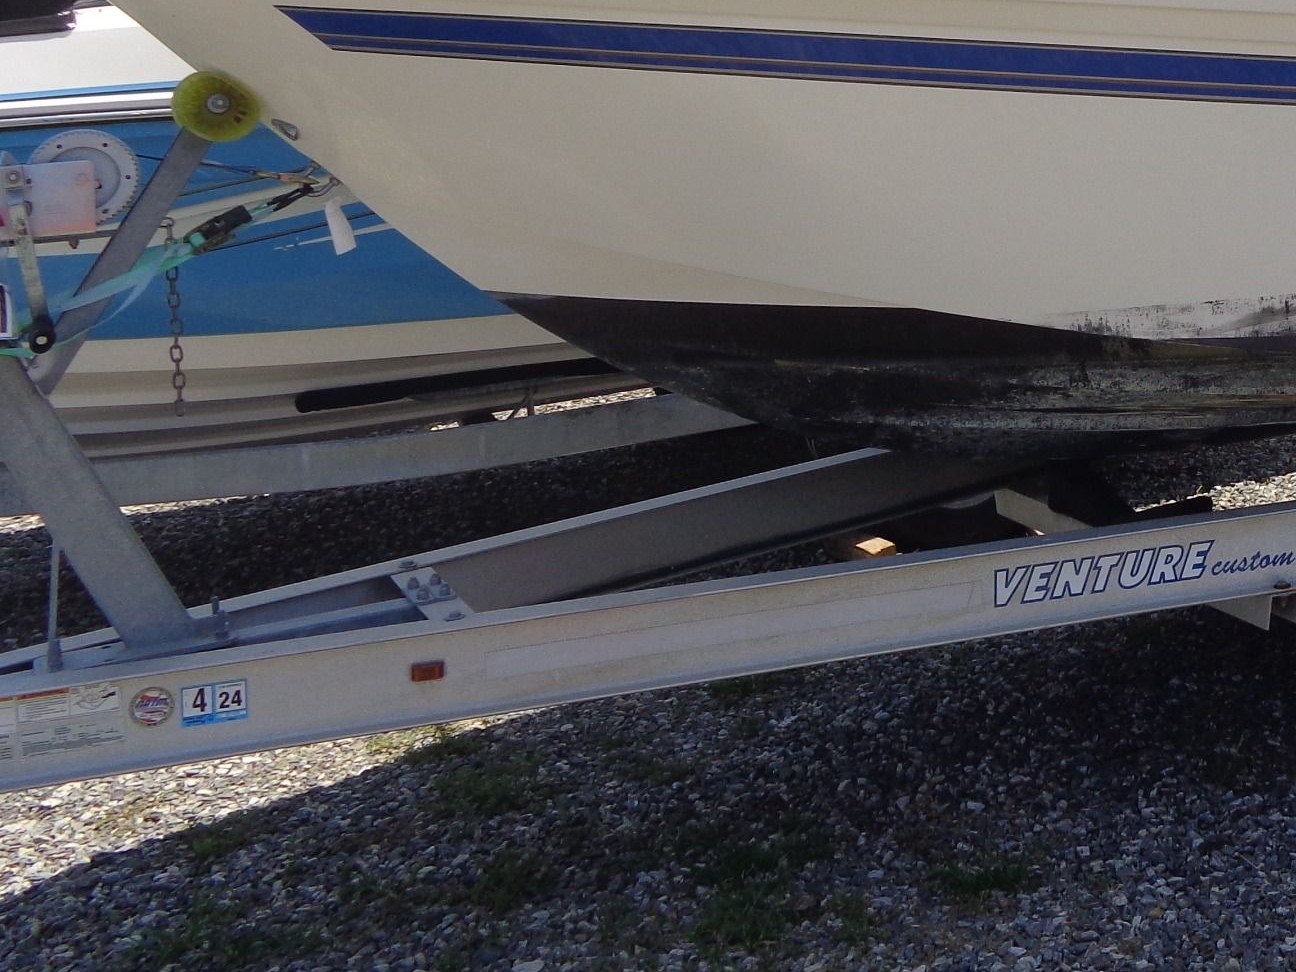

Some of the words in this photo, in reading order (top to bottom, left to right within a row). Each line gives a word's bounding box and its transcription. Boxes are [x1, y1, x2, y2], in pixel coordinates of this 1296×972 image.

[993, 539, 1216, 608] VENTURE
[1211, 549, 1296, 577] custom
[192, 687, 208, 713] 4
[218, 689, 243, 710] 24
